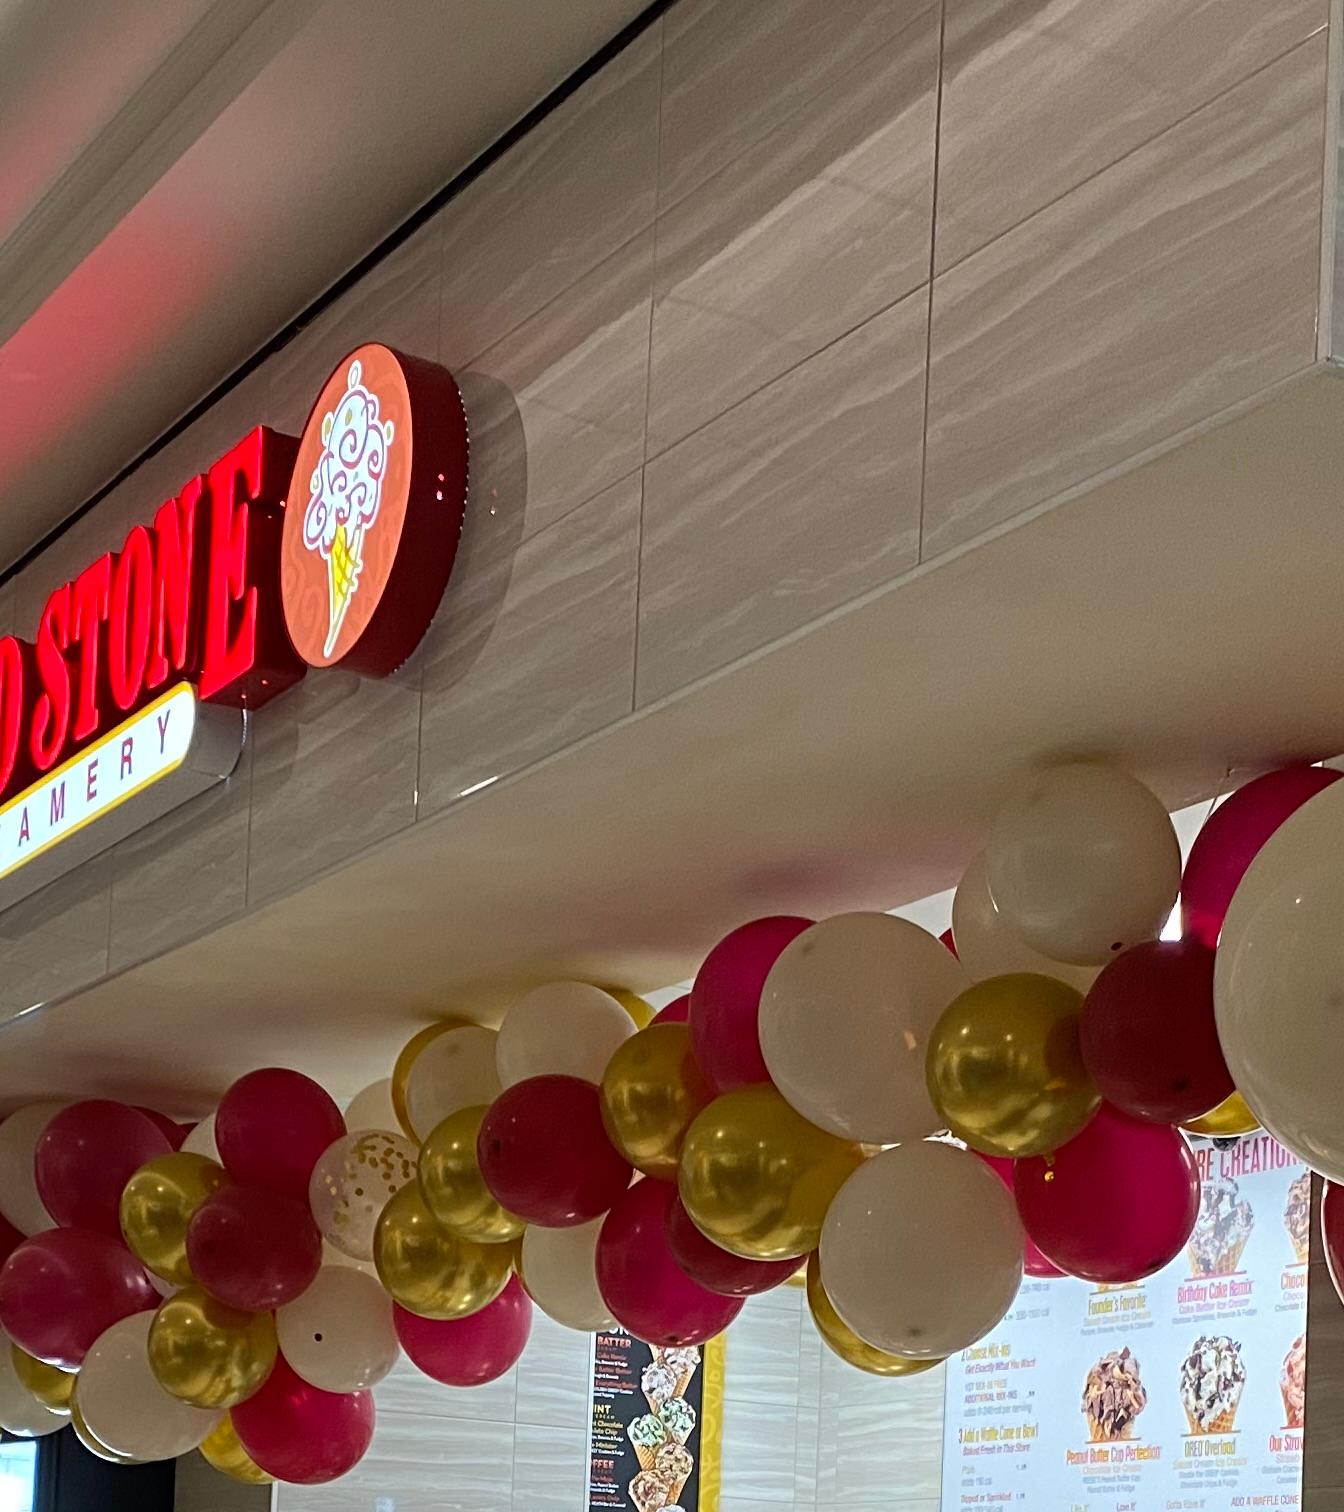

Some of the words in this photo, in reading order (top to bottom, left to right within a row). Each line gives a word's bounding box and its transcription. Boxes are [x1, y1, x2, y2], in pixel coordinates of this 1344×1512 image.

[30, 424, 265, 772] STONE
[1281, 1272, 1305, 1290] Choco
[597, 1336, 632, 1348] BATTER
[593, 1404, 611, 1414] INT
[591, 1459, 614, 1470] FFEE
